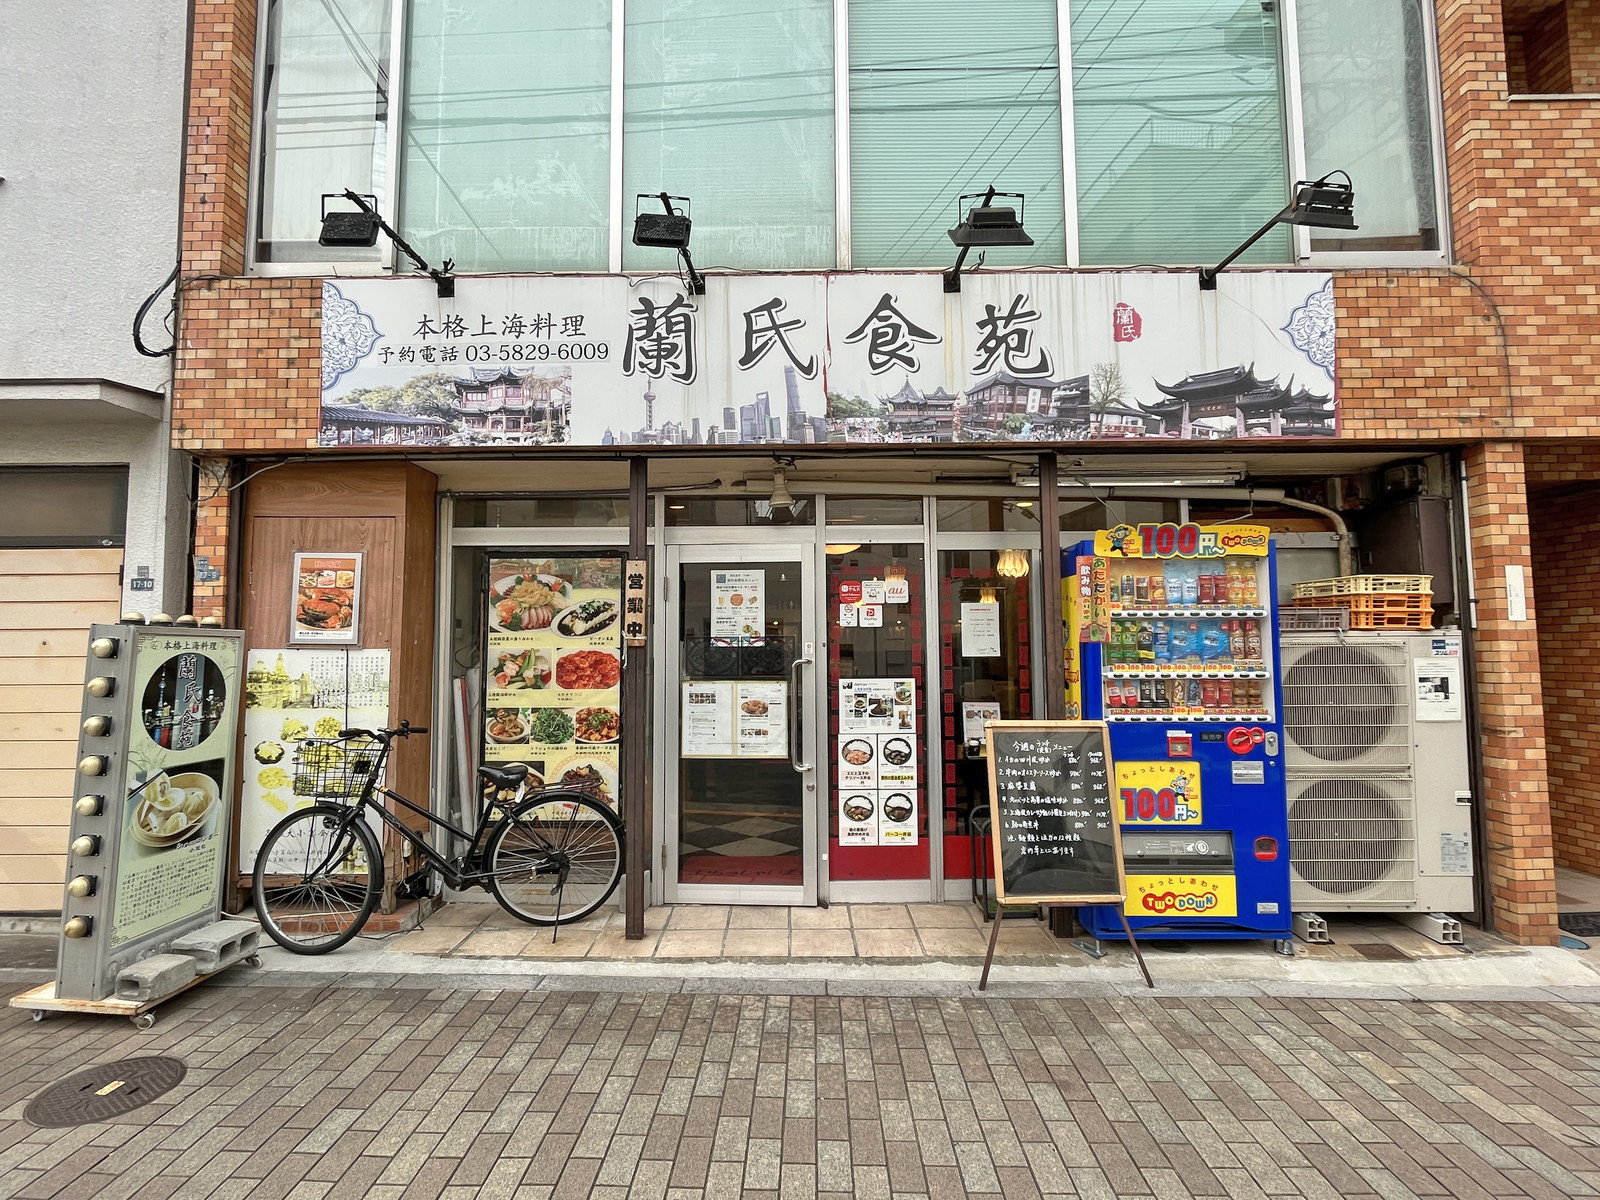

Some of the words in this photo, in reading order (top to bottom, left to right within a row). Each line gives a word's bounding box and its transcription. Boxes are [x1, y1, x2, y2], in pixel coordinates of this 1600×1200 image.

[413, 314, 587, 342] 本格上海料理
[1116, 307, 1138, 339] 蘭氏
[622, 292, 1052, 386] 蘭氏食苑
[377, 345, 460, 365] 予約電話
[465, 343, 610, 363] 03-5829-6009
[133, 581, 153, 589] 17-10
[888, 587, 905, 595] au
[1093, 557, 1106, 618] あたたかい
[627, 573, 644, 638] 営業中
[1122, 765, 1195, 780] ちょっとしあわせ
[1139, 876, 1219, 893] ちょっとしあわせ
[1147, 897, 1174, 910] TWO
[1178, 896, 1213, 909] DOWN
